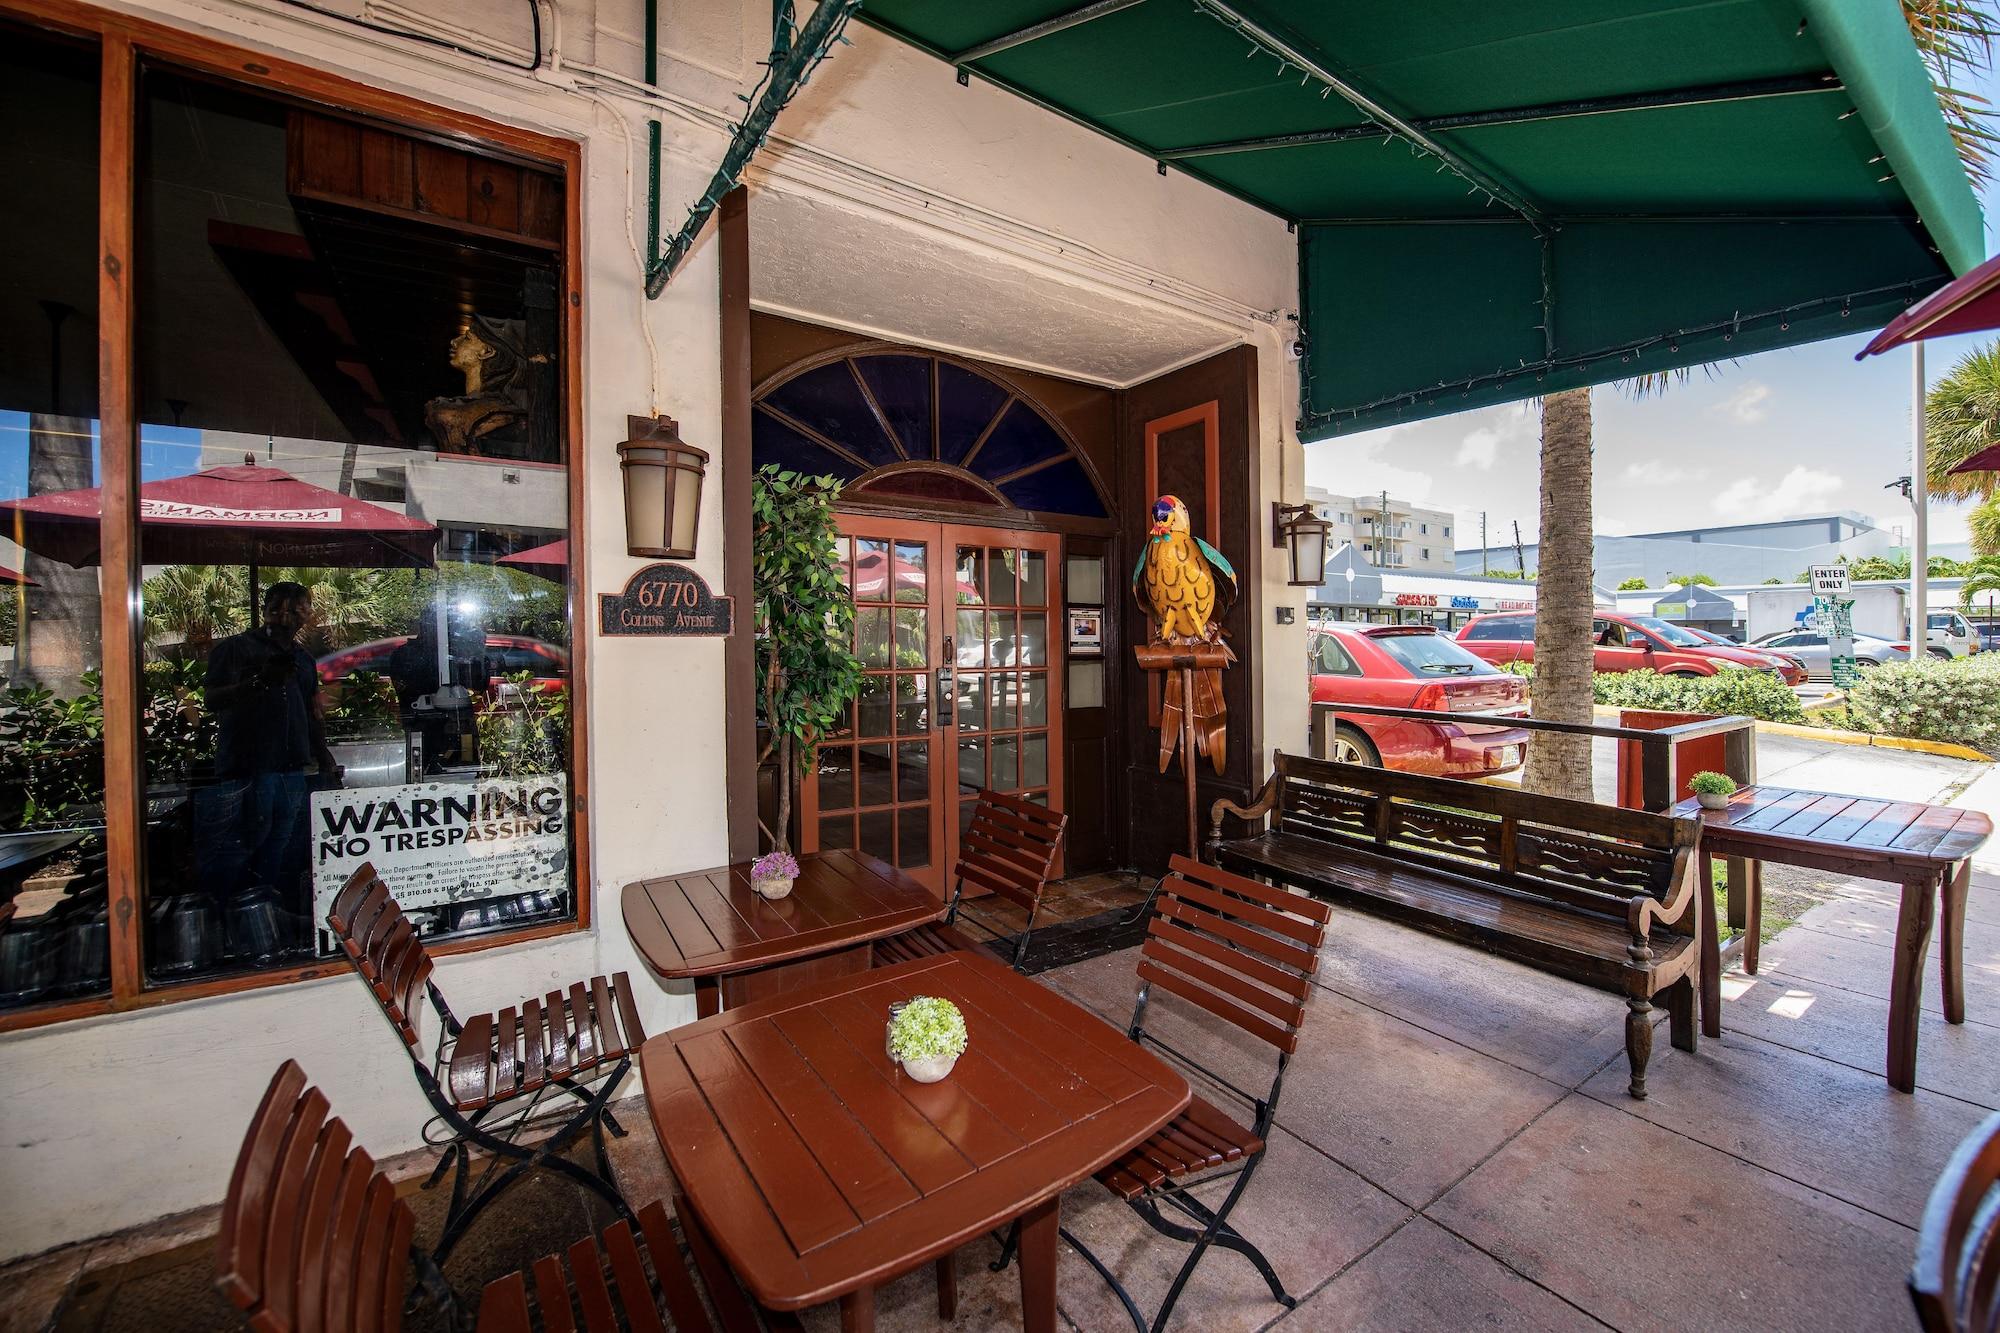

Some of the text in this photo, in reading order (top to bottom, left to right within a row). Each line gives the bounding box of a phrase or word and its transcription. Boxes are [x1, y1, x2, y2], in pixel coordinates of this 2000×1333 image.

[1815, 569, 1846, 578] ENTER
[1819, 580, 1843, 589] ONLY
[639, 581, 698, 608] 6770
[320, 786, 563, 837] WARNING
[320, 816, 563, 860] NO TRESPASSING
